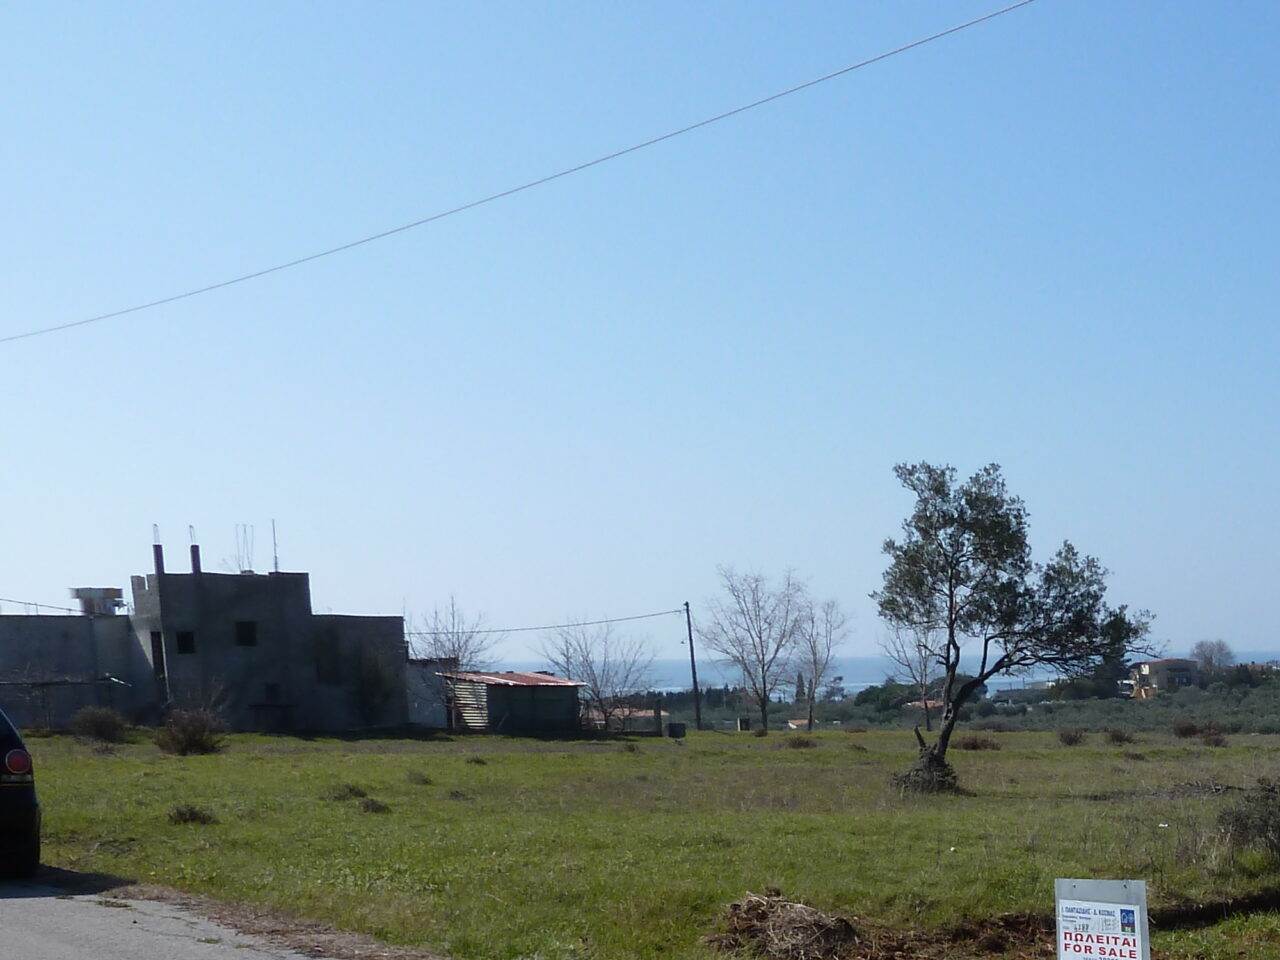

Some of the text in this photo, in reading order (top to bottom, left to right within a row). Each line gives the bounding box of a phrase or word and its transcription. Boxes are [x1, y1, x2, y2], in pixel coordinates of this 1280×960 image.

[1064, 932, 1137, 947] ΠΩΛΕΙΤΑΙ
[1064, 943, 1138, 959] FOR SALE
